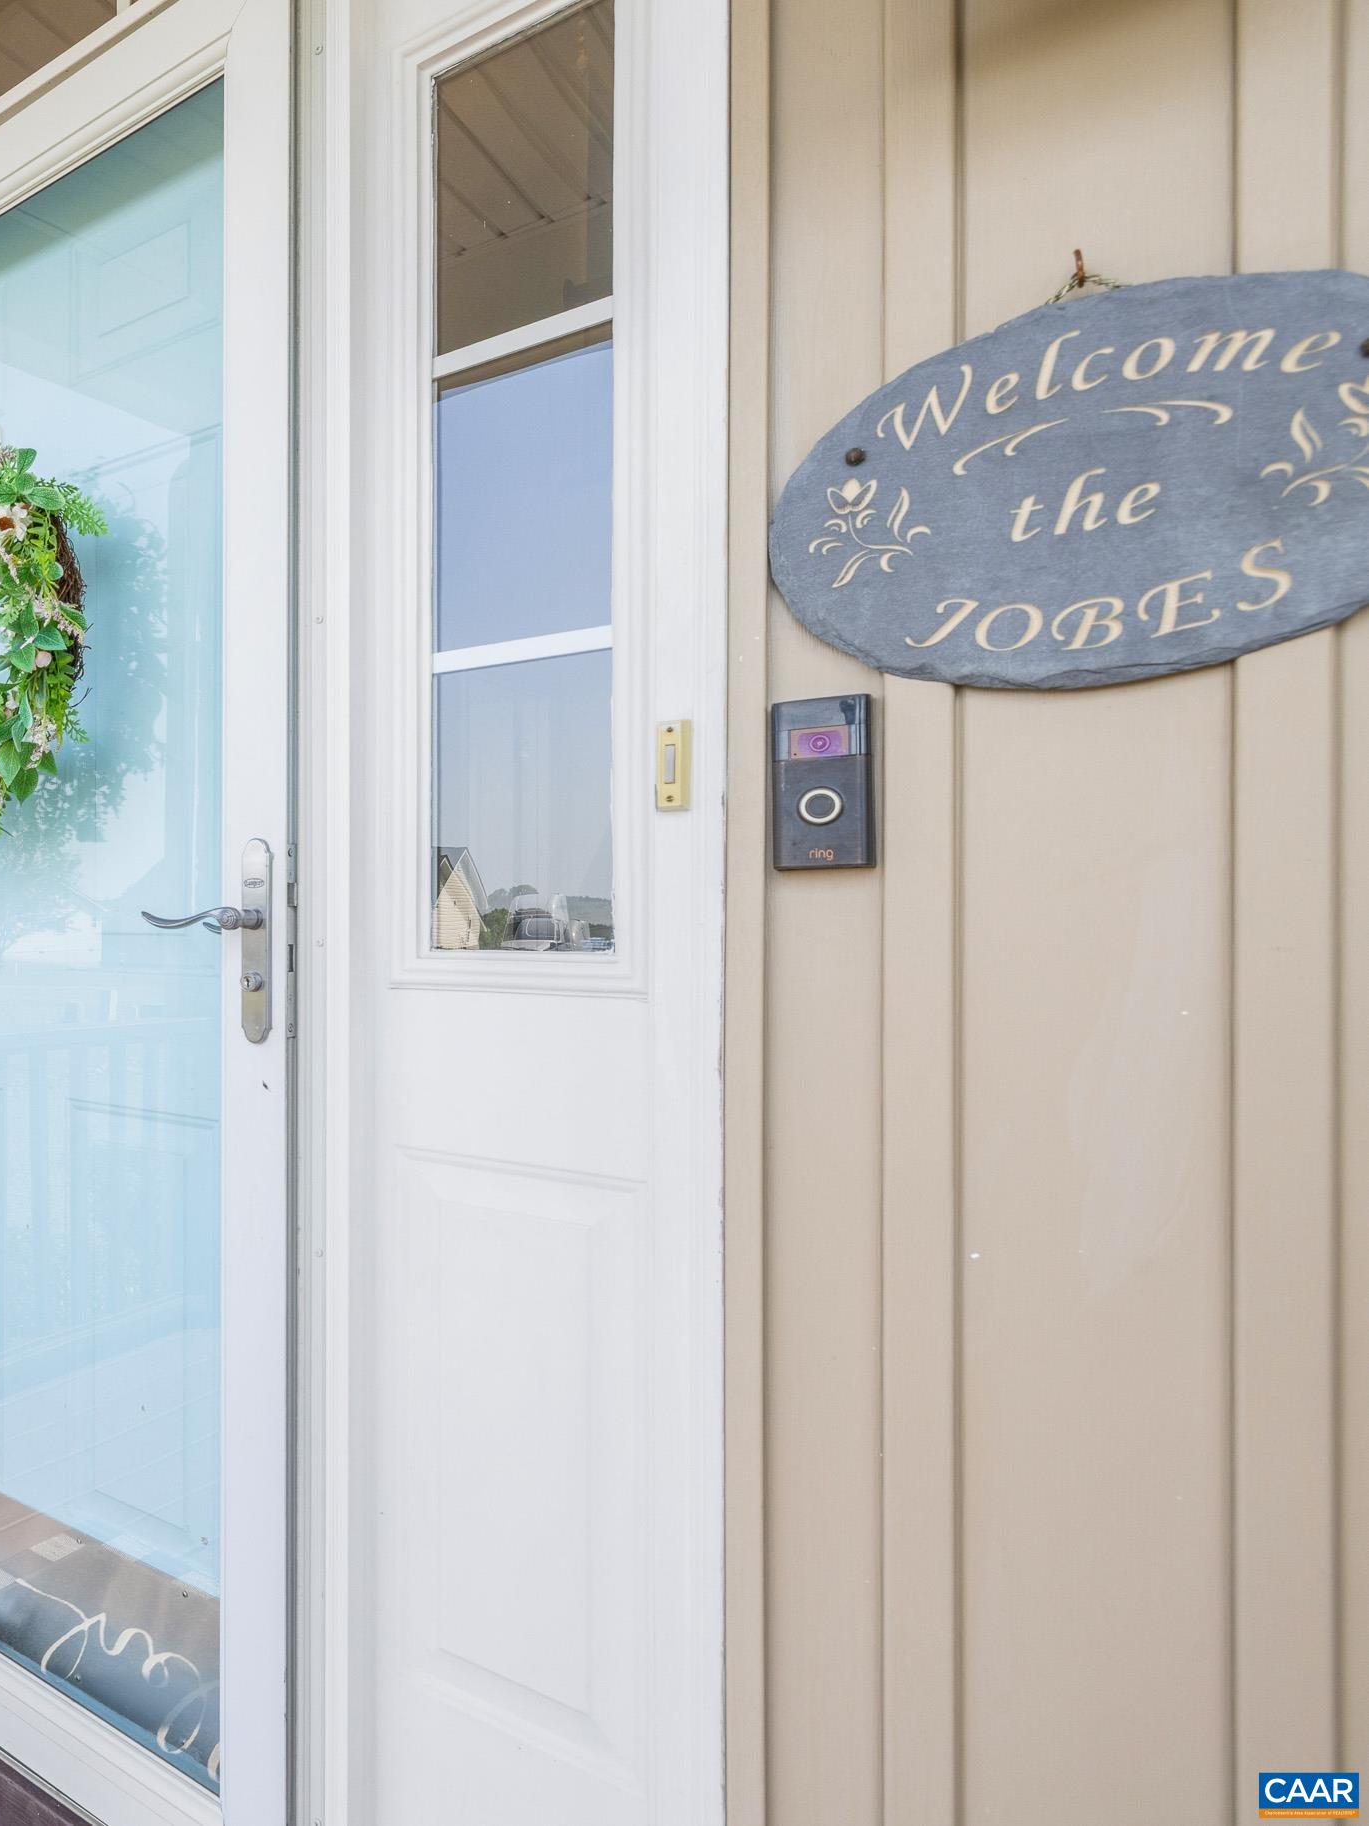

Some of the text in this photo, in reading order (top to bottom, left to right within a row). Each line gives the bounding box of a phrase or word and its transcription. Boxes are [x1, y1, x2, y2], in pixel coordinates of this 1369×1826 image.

[877, 327, 1341, 451] Welcome
[1011, 469, 1161, 542] the
[905, 539, 1293, 652] JOBES
[809, 847, 834, 861] ring
